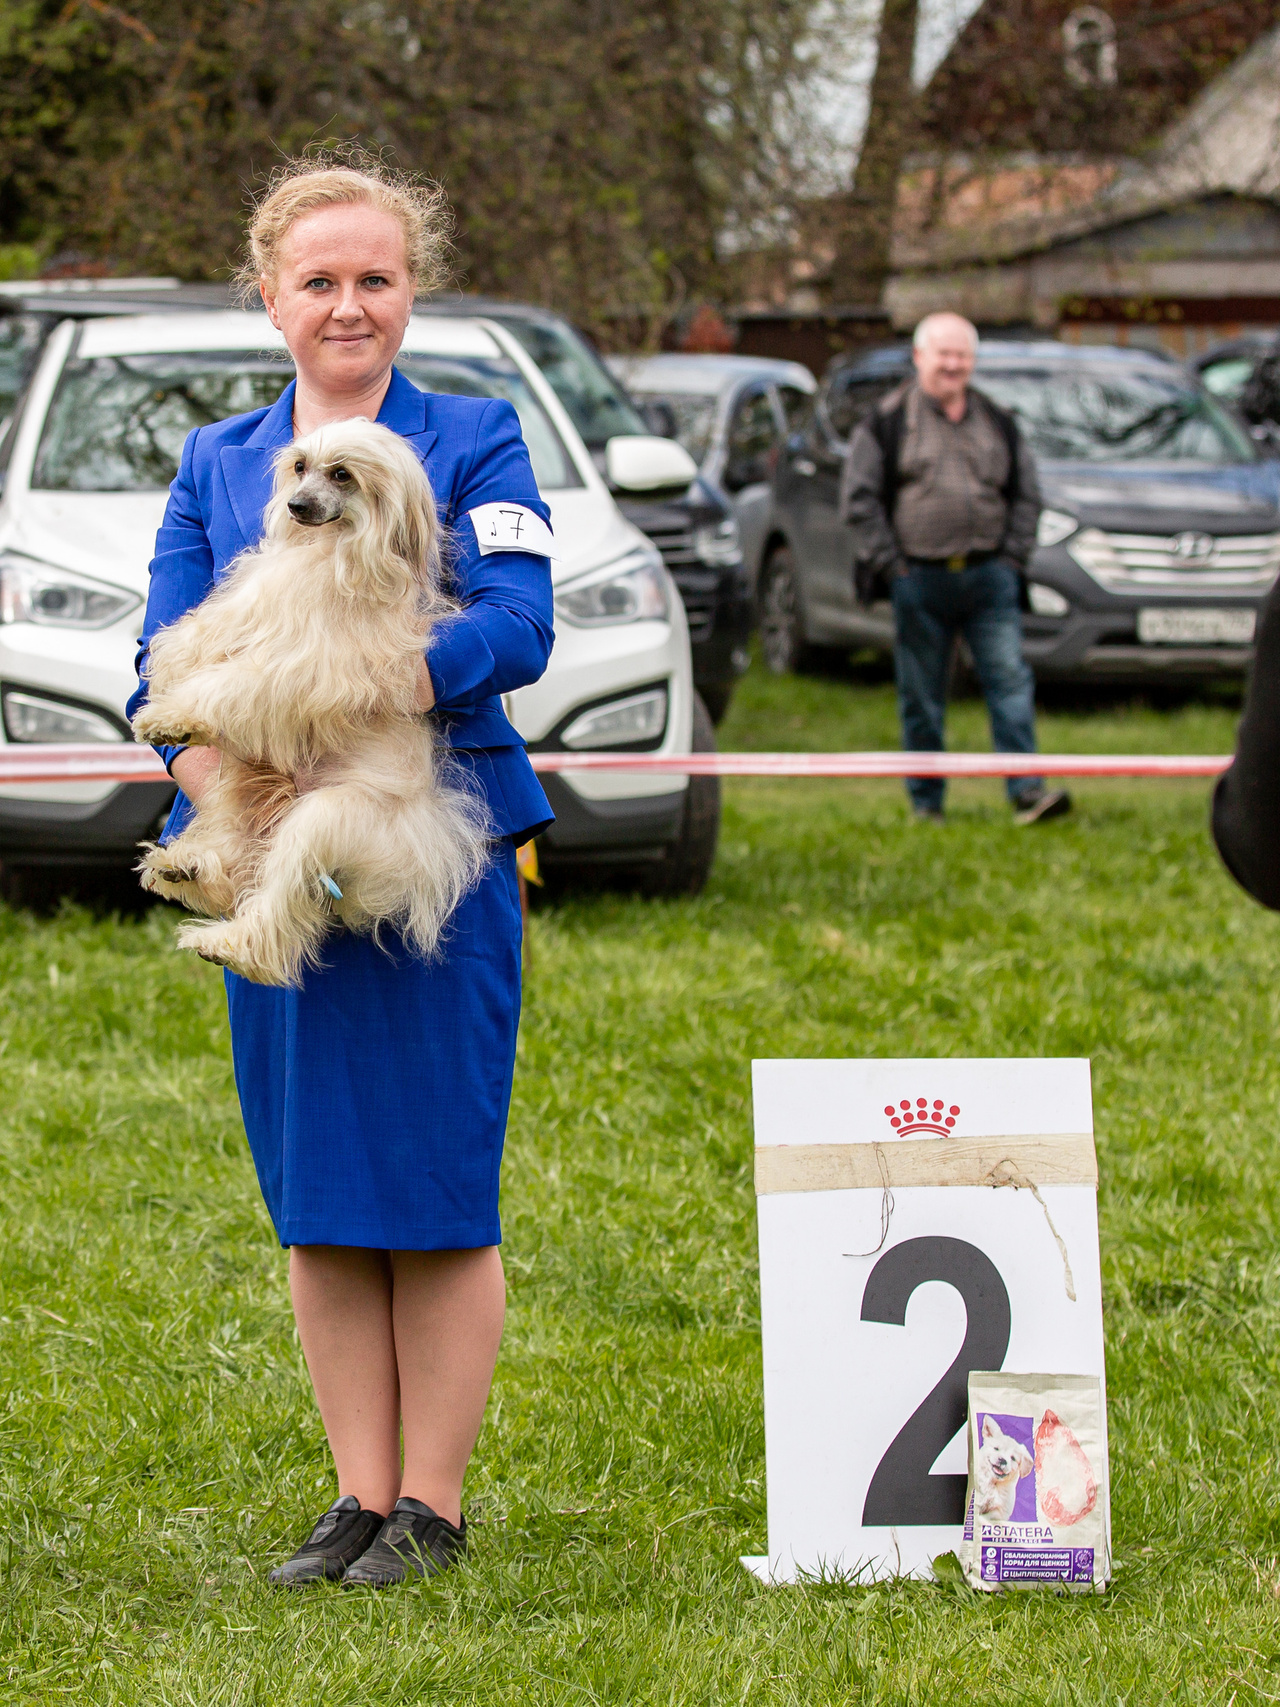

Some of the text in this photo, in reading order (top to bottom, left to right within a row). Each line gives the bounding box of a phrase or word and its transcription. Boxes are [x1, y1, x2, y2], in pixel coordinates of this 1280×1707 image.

[861, 1236, 1011, 1526] 2
[993, 1525, 1053, 1537] STATERA
[1003, 1552, 1070, 1560] СБАЛАНСИРОВАННЫЙ
